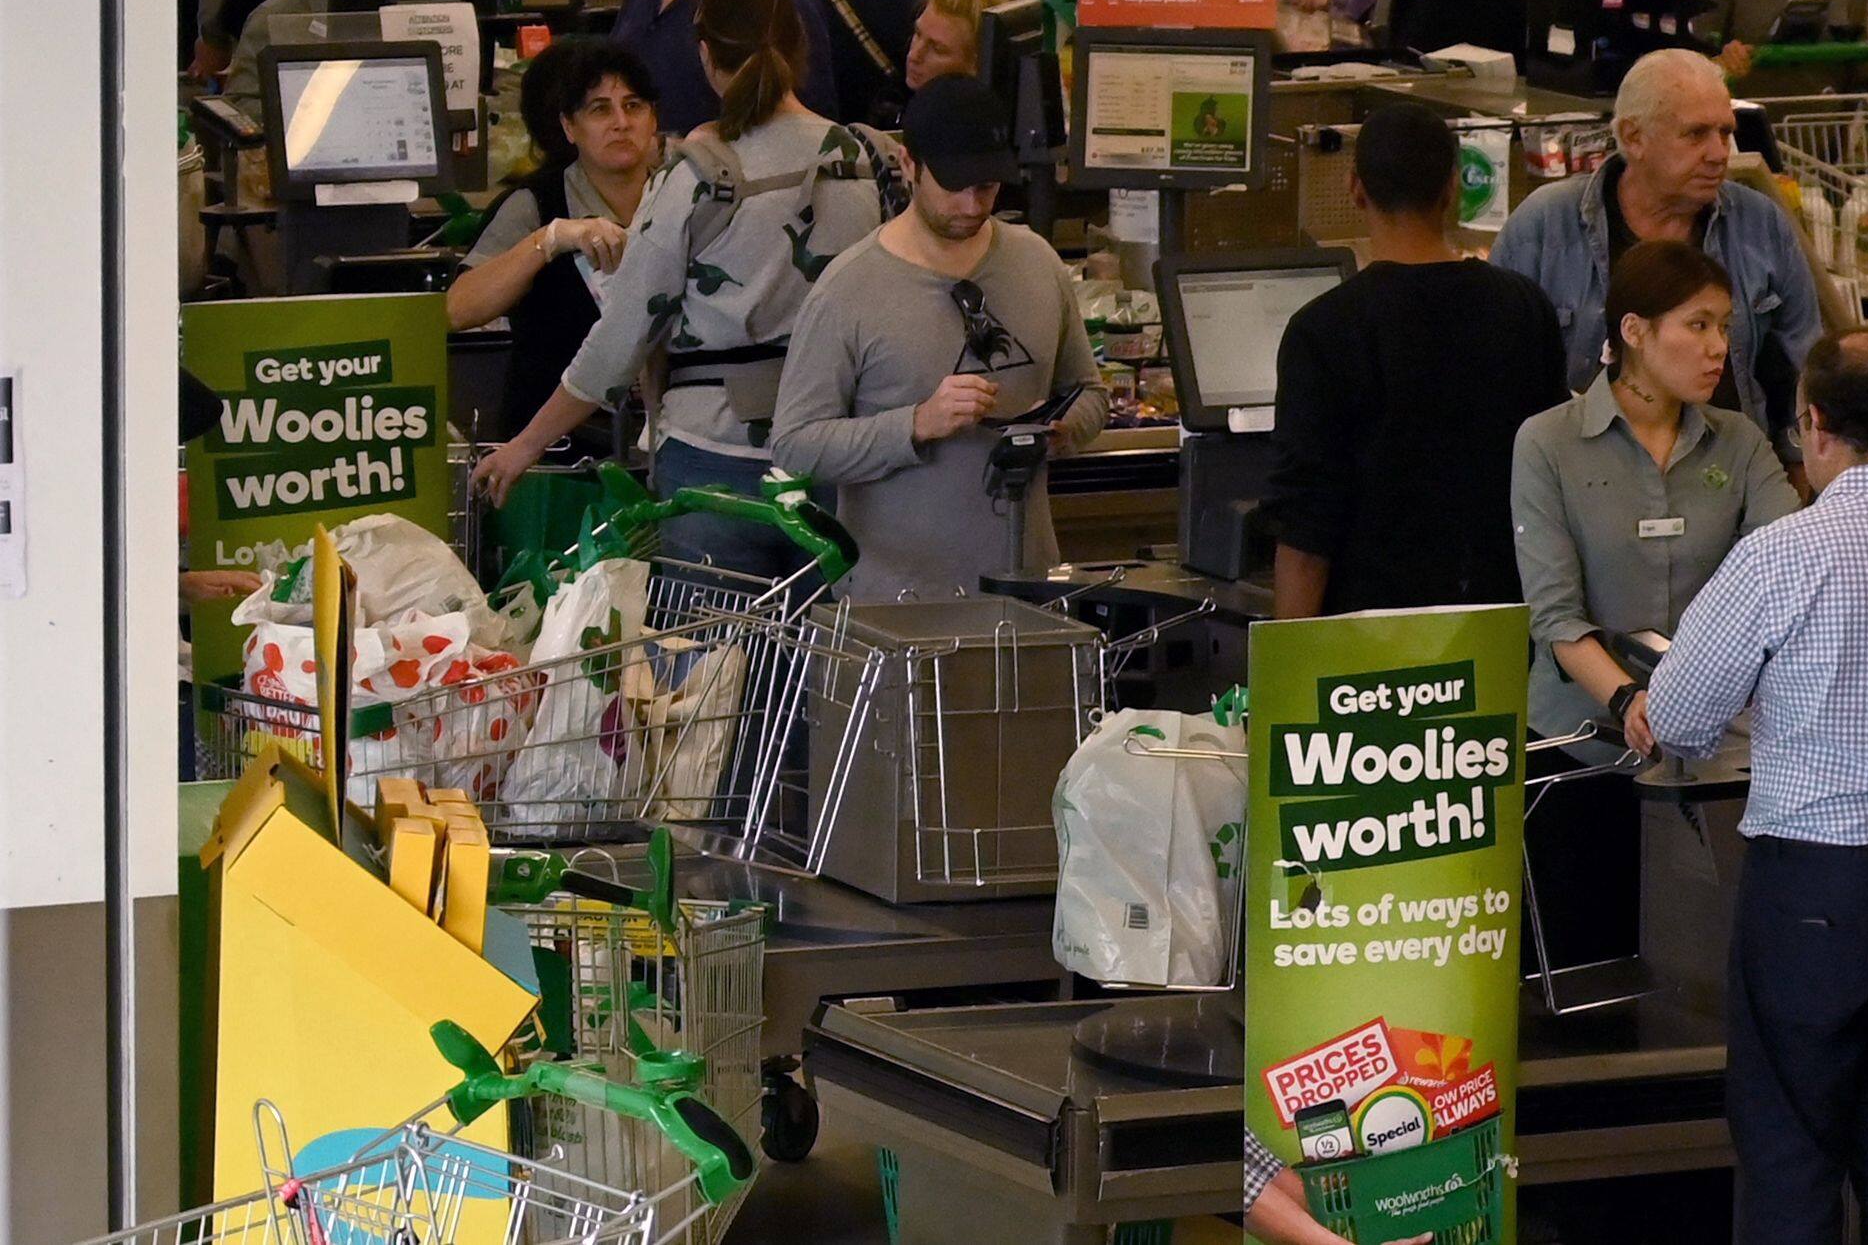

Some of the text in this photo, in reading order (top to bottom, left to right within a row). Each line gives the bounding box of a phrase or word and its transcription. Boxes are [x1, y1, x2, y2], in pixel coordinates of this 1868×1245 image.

[442, 45, 464, 56] ORE
[255, 354, 381, 386] Get your
[220, 394, 428, 444] Woolies
[225, 446, 405, 509] worth!
[1329, 679, 1465, 716] Get your
[1284, 726, 1510, 786] Woolies
[1292, 785, 1486, 862] worth!
[1270, 887, 1511, 930] Lots of ways to
[1273, 924, 1507, 967] save every day
[1275, 1032, 1383, 1097] PRICES
[1285, 1056, 1389, 1115] DROPPED
[1459, 1068, 1494, 1096] PRICE
[1433, 1083, 1497, 1127] ALWAYS
[1366, 1116, 1421, 1148] Special
